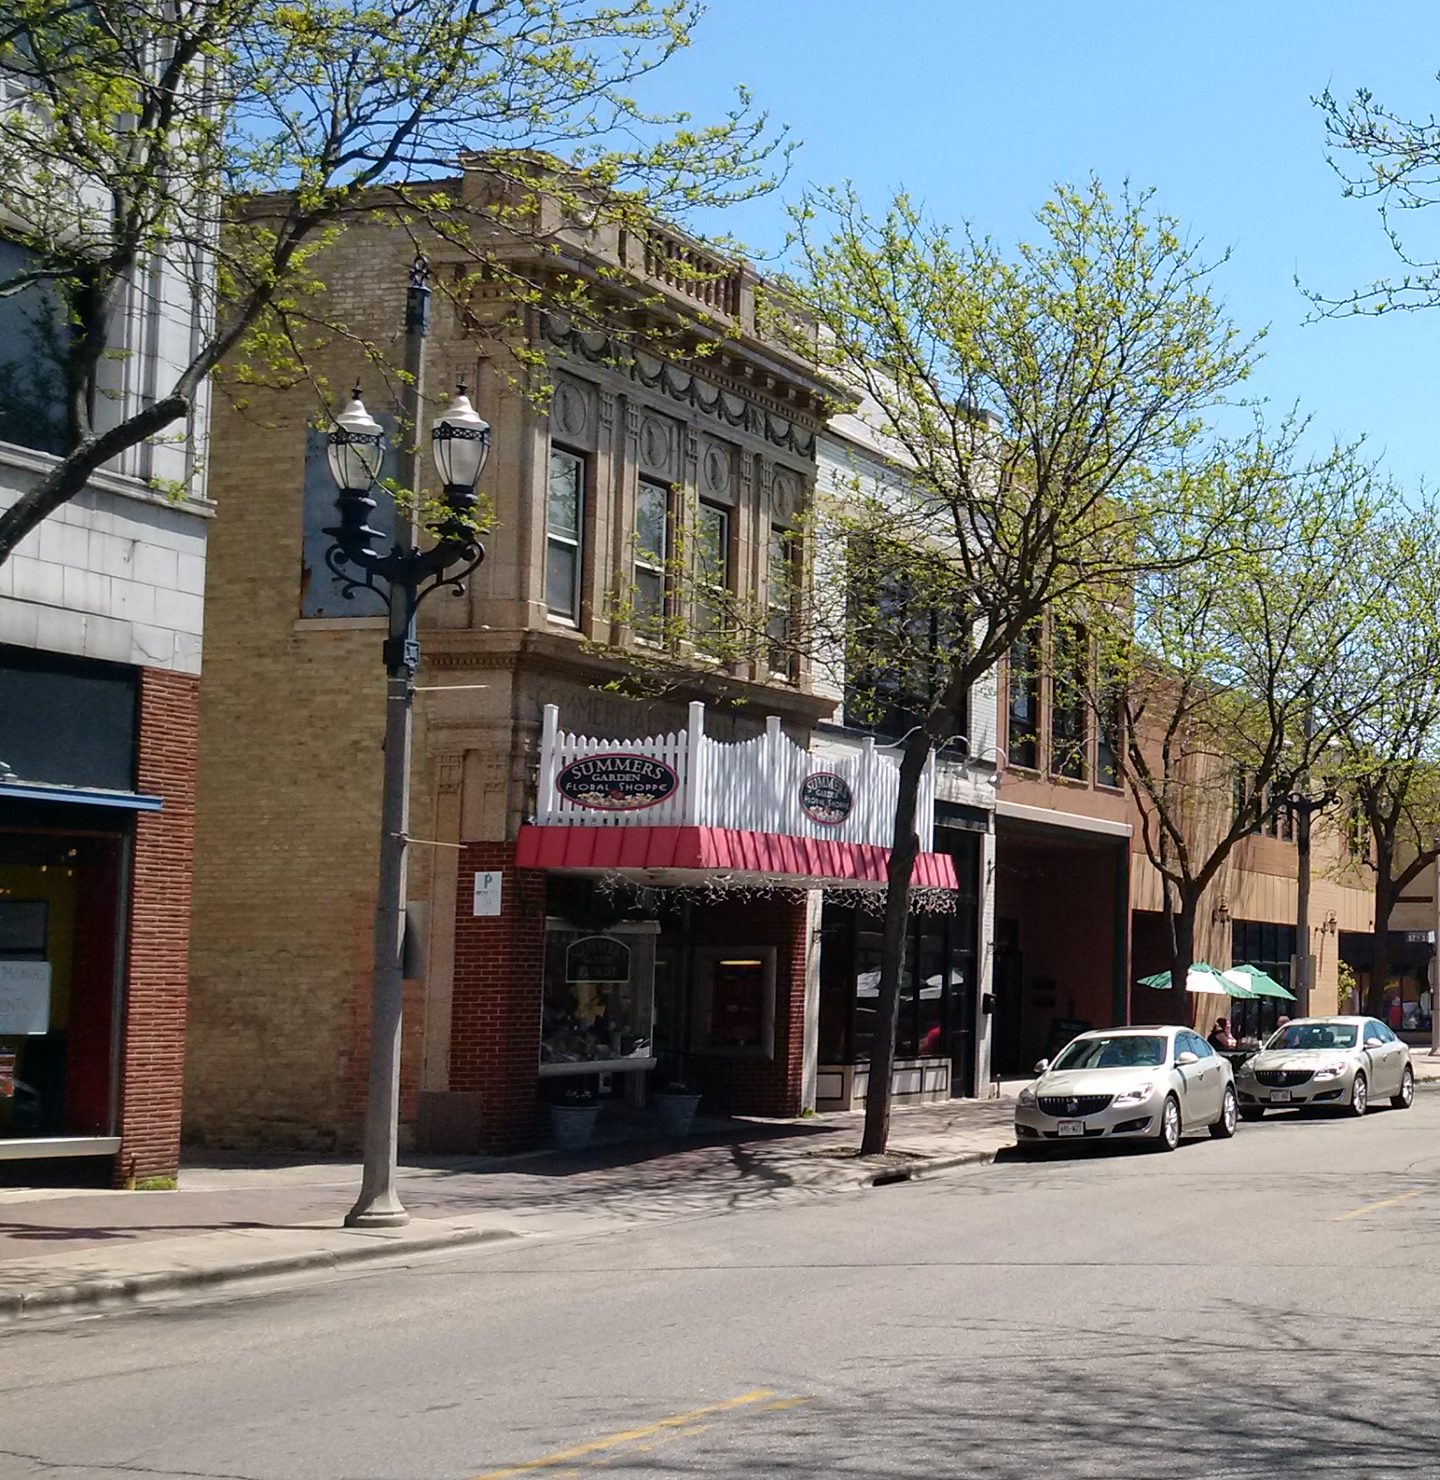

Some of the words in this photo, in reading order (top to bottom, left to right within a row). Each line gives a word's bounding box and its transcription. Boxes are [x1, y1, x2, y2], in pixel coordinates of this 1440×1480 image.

[571, 758, 664, 779] SUMMERS
[592, 773, 640, 782] GARDEN
[565, 782, 609, 791] FLORAL
[619, 782, 668, 791] SHOPPE
